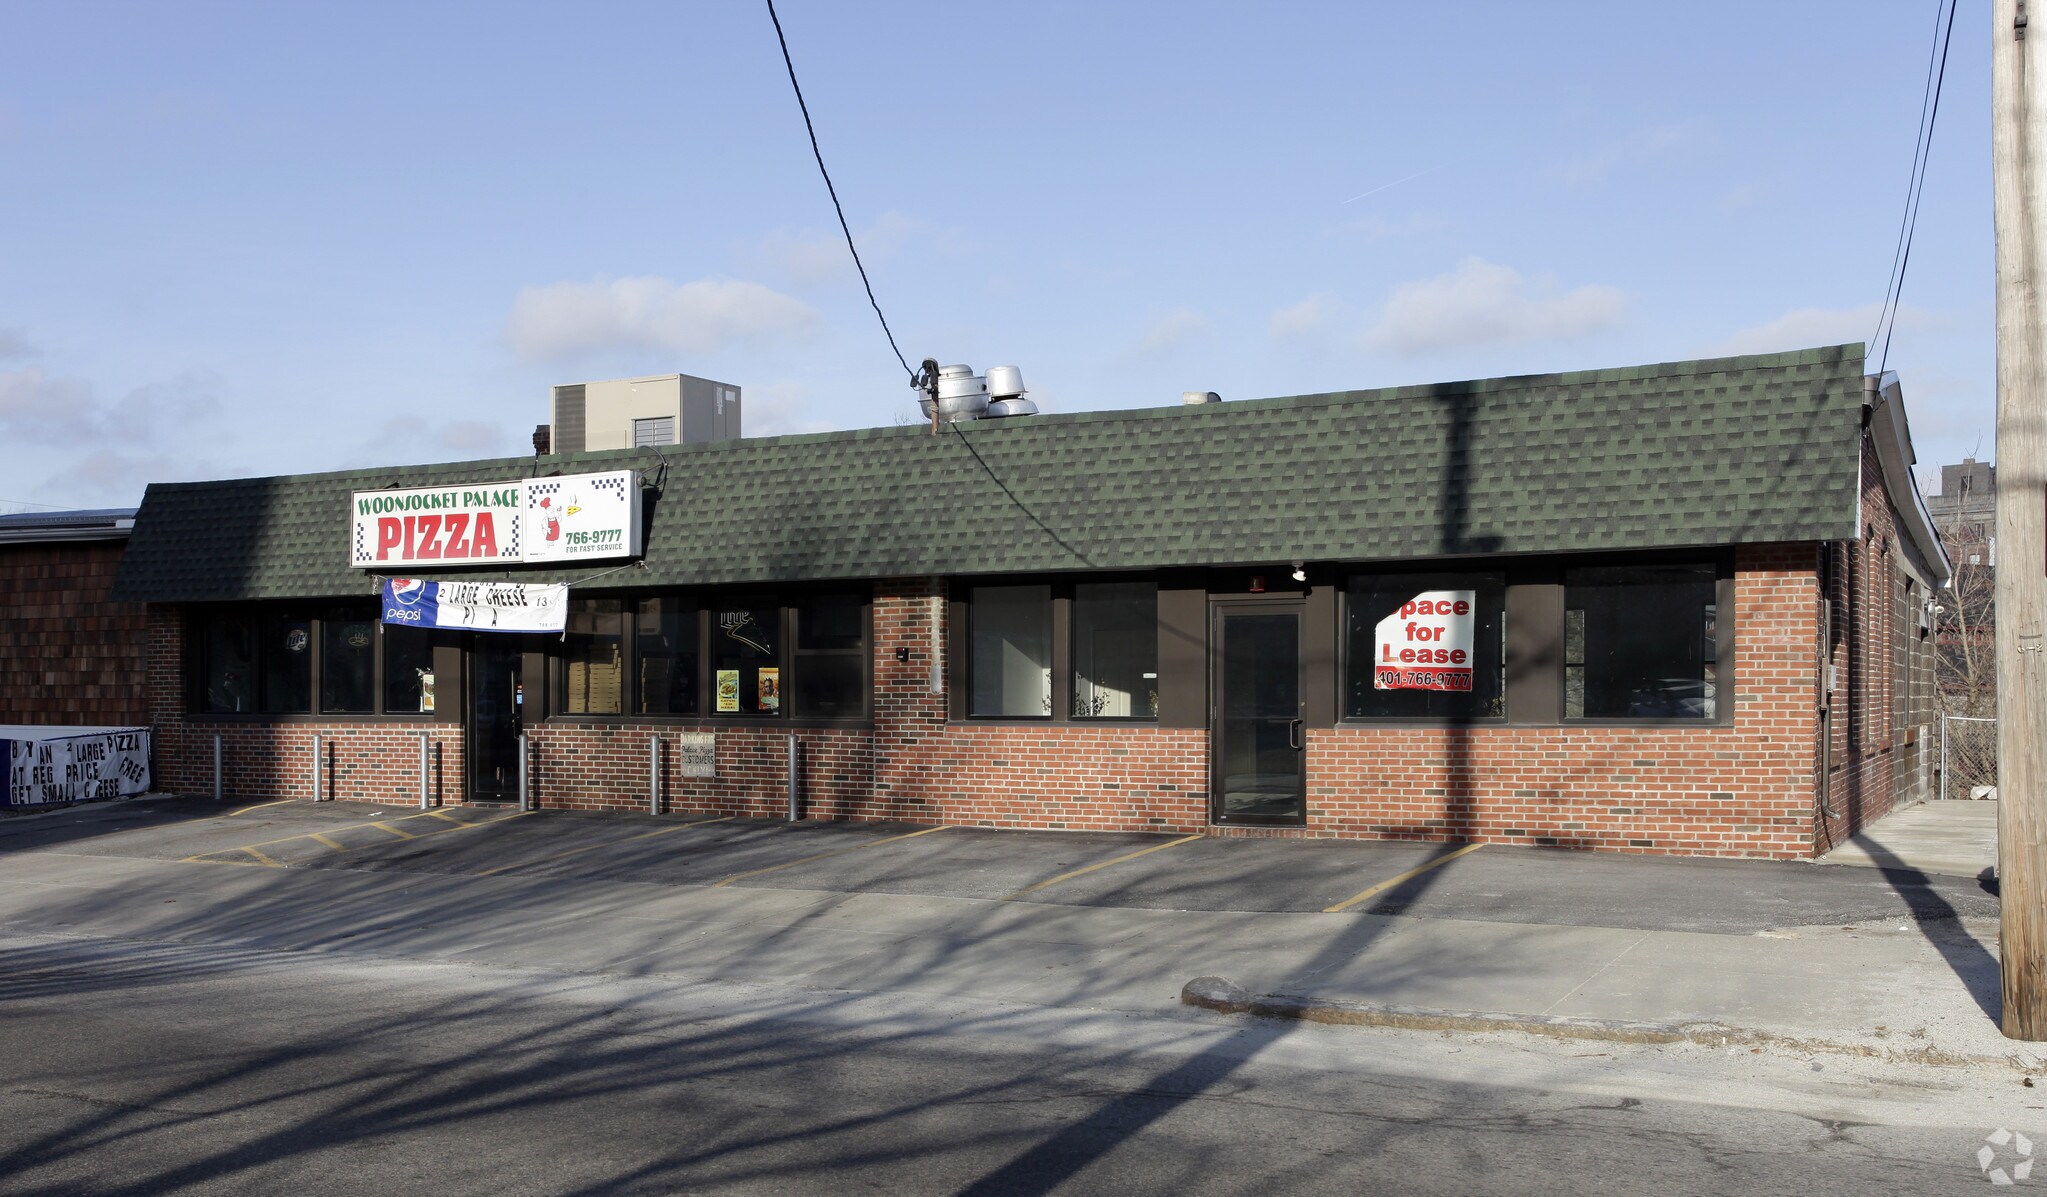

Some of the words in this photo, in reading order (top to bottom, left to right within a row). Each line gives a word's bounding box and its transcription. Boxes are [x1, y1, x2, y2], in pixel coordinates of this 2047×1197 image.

[358, 492, 458, 516] WOONSOCKET
[463, 489, 519, 508] PALACE
[376, 512, 498, 561] PIZZA
[566, 529, 622, 545] 766-9777
[597, 543, 623, 551] SERVICE
[439, 588, 445, 598] 2
[450, 584, 479, 605] LARGE
[486, 588, 528, 607] CHEESE
[386, 608, 421, 621] pepsi
[1392, 600, 1470, 619] pace
[1405, 622, 1445, 641] for
[1382, 643, 1467, 664] Lease
[1377, 671, 1470, 687] 401-766-9777
[66, 742, 72, 752] 2
[76, 742, 105, 763] LARGE
[107, 734, 140, 753] PIZZA
[11, 785, 32, 804] GET
[42, 781, 76, 802] SMALL
[118, 757, 145, 783] FREE
[12, 767, 24, 786] AT
[33, 766, 53, 785] REG
[66, 762, 98, 782] PRICE
